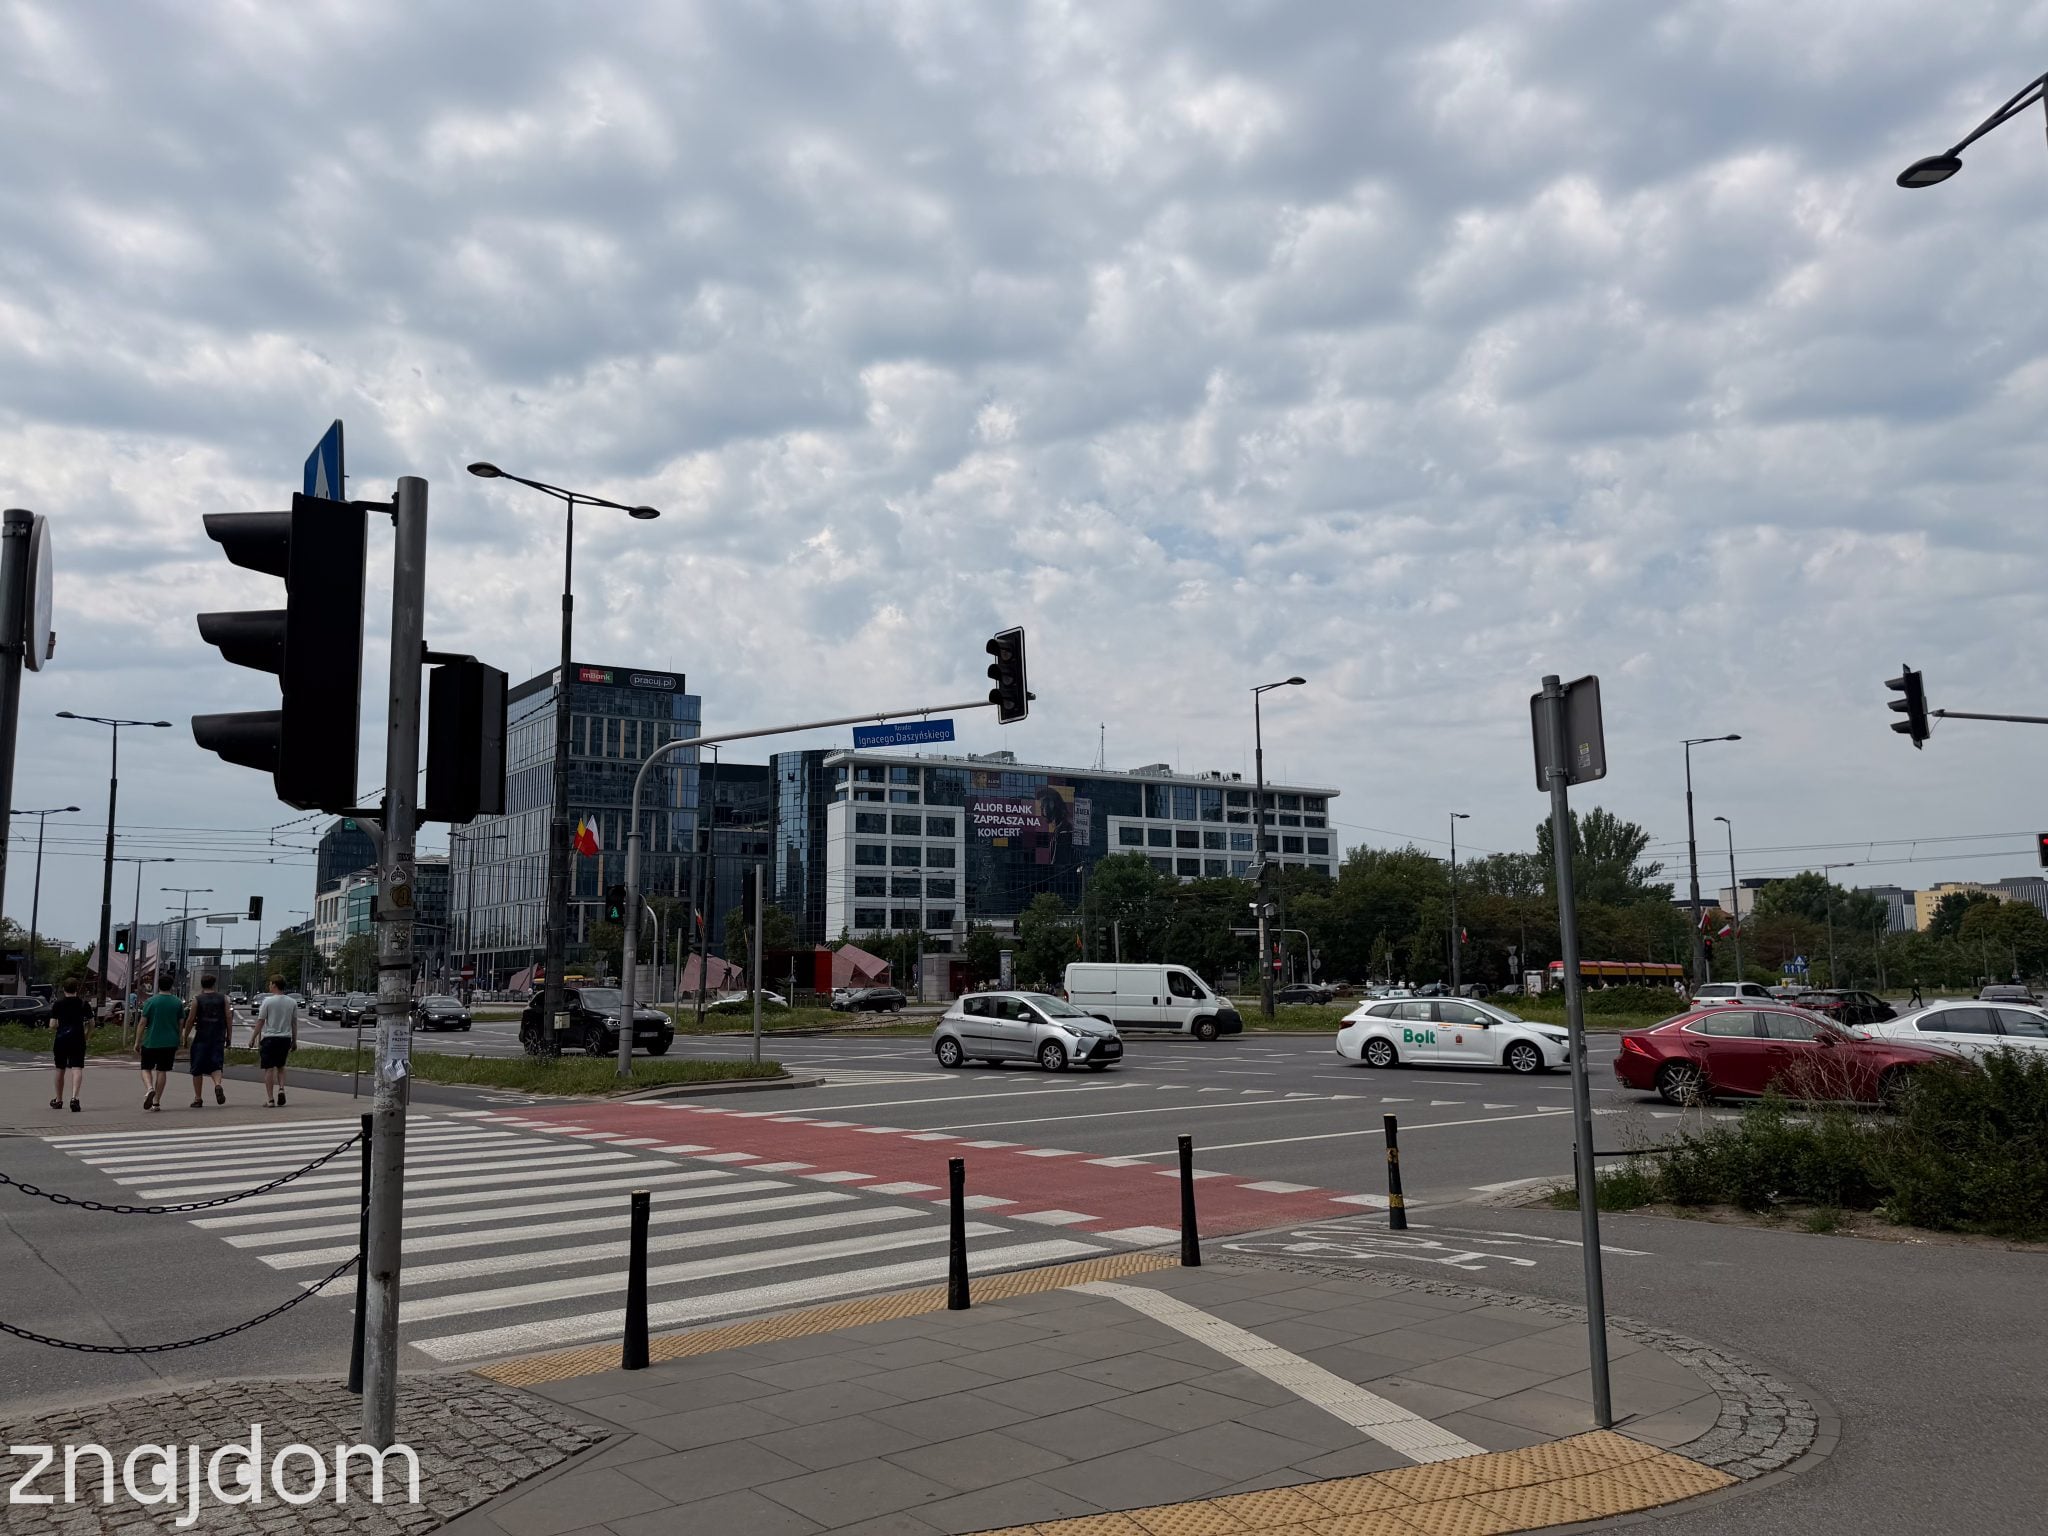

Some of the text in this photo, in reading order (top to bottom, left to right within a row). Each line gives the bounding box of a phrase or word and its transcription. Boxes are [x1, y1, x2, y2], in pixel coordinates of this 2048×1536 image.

[582, 671, 611, 681] mBank
[634, 676, 672, 687] pracuj.pl
[859, 730, 950, 747] Ignacego Daszyńskiego
[973, 803, 1032, 814] ALIOR BANK
[973, 815, 1041, 827] ZAPRASZA NA
[977, 828, 1021, 837] KONCERT
[1403, 1029, 1436, 1047] Bolt
